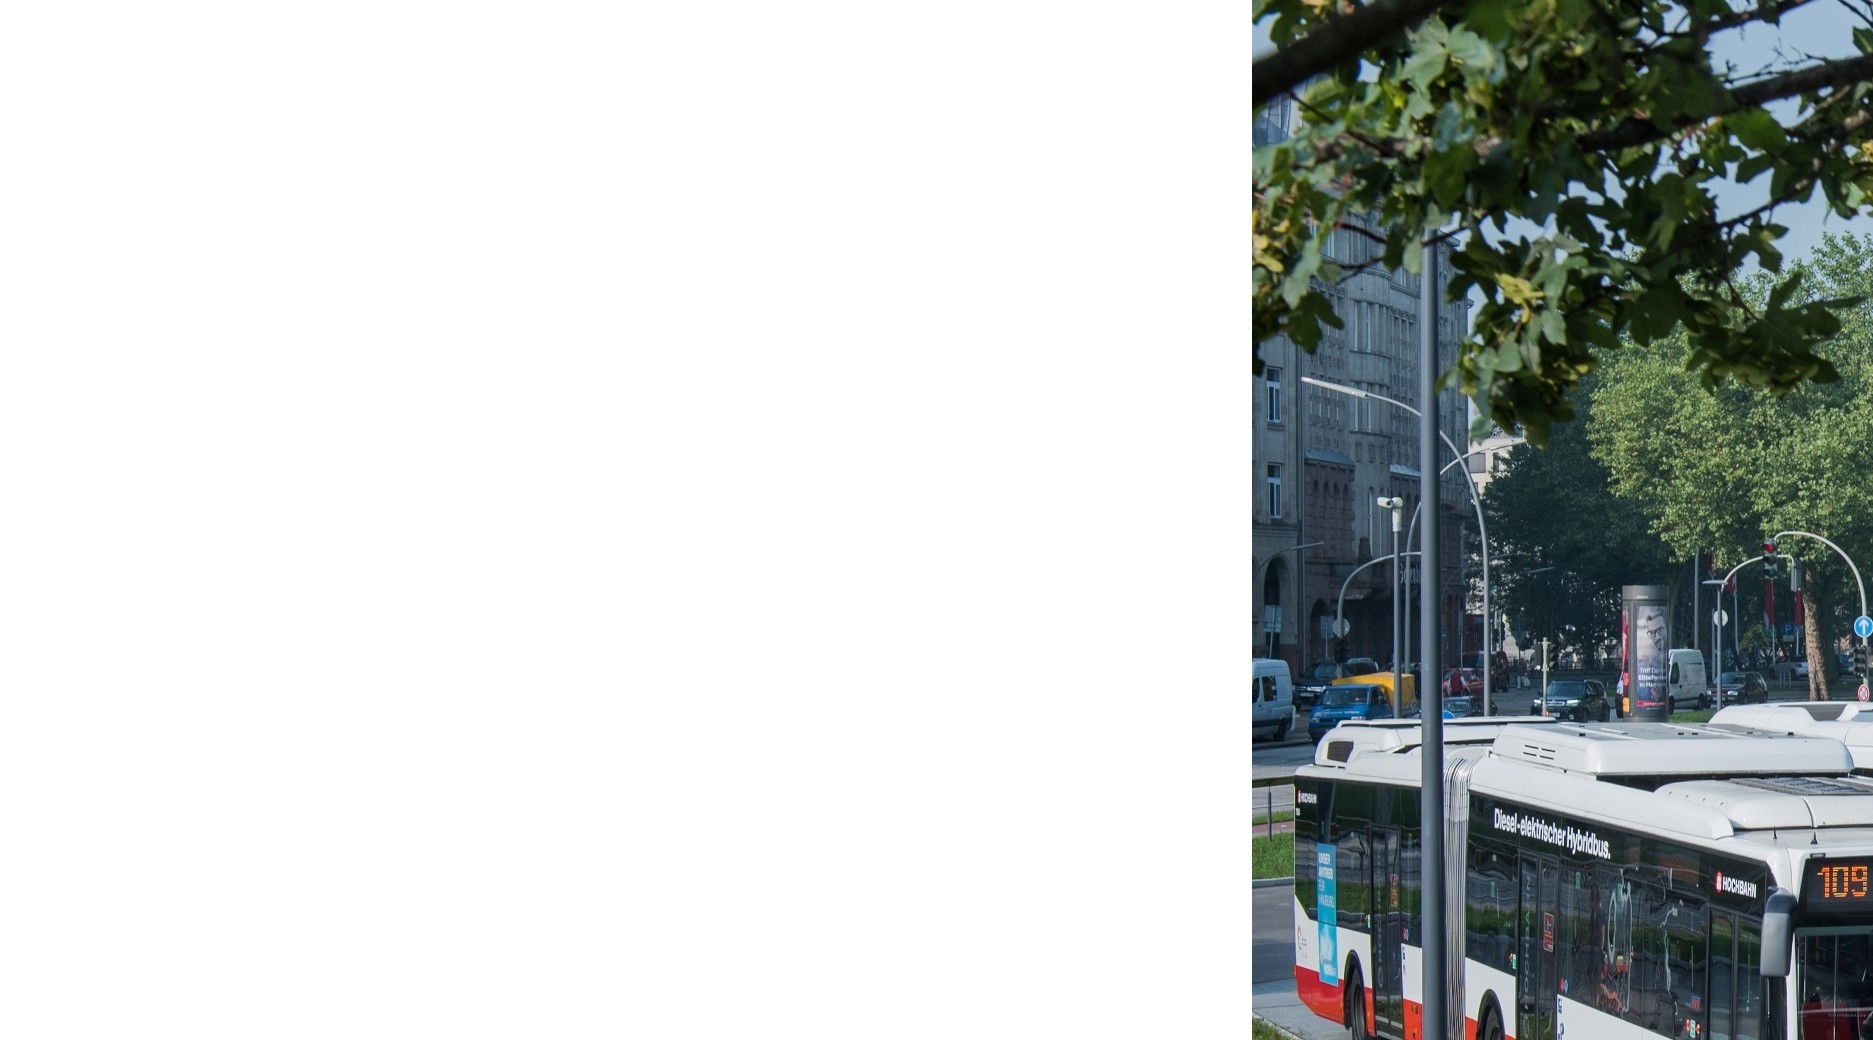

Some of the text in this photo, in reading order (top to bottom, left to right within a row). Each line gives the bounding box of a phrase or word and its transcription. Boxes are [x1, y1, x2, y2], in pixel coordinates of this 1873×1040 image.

[1494, 808, 1611, 859] Diesel-elektrischer Hybridbus.
[1722, 876, 1757, 899] HOCHBAHN
[1817, 865, 1868, 898] 109
